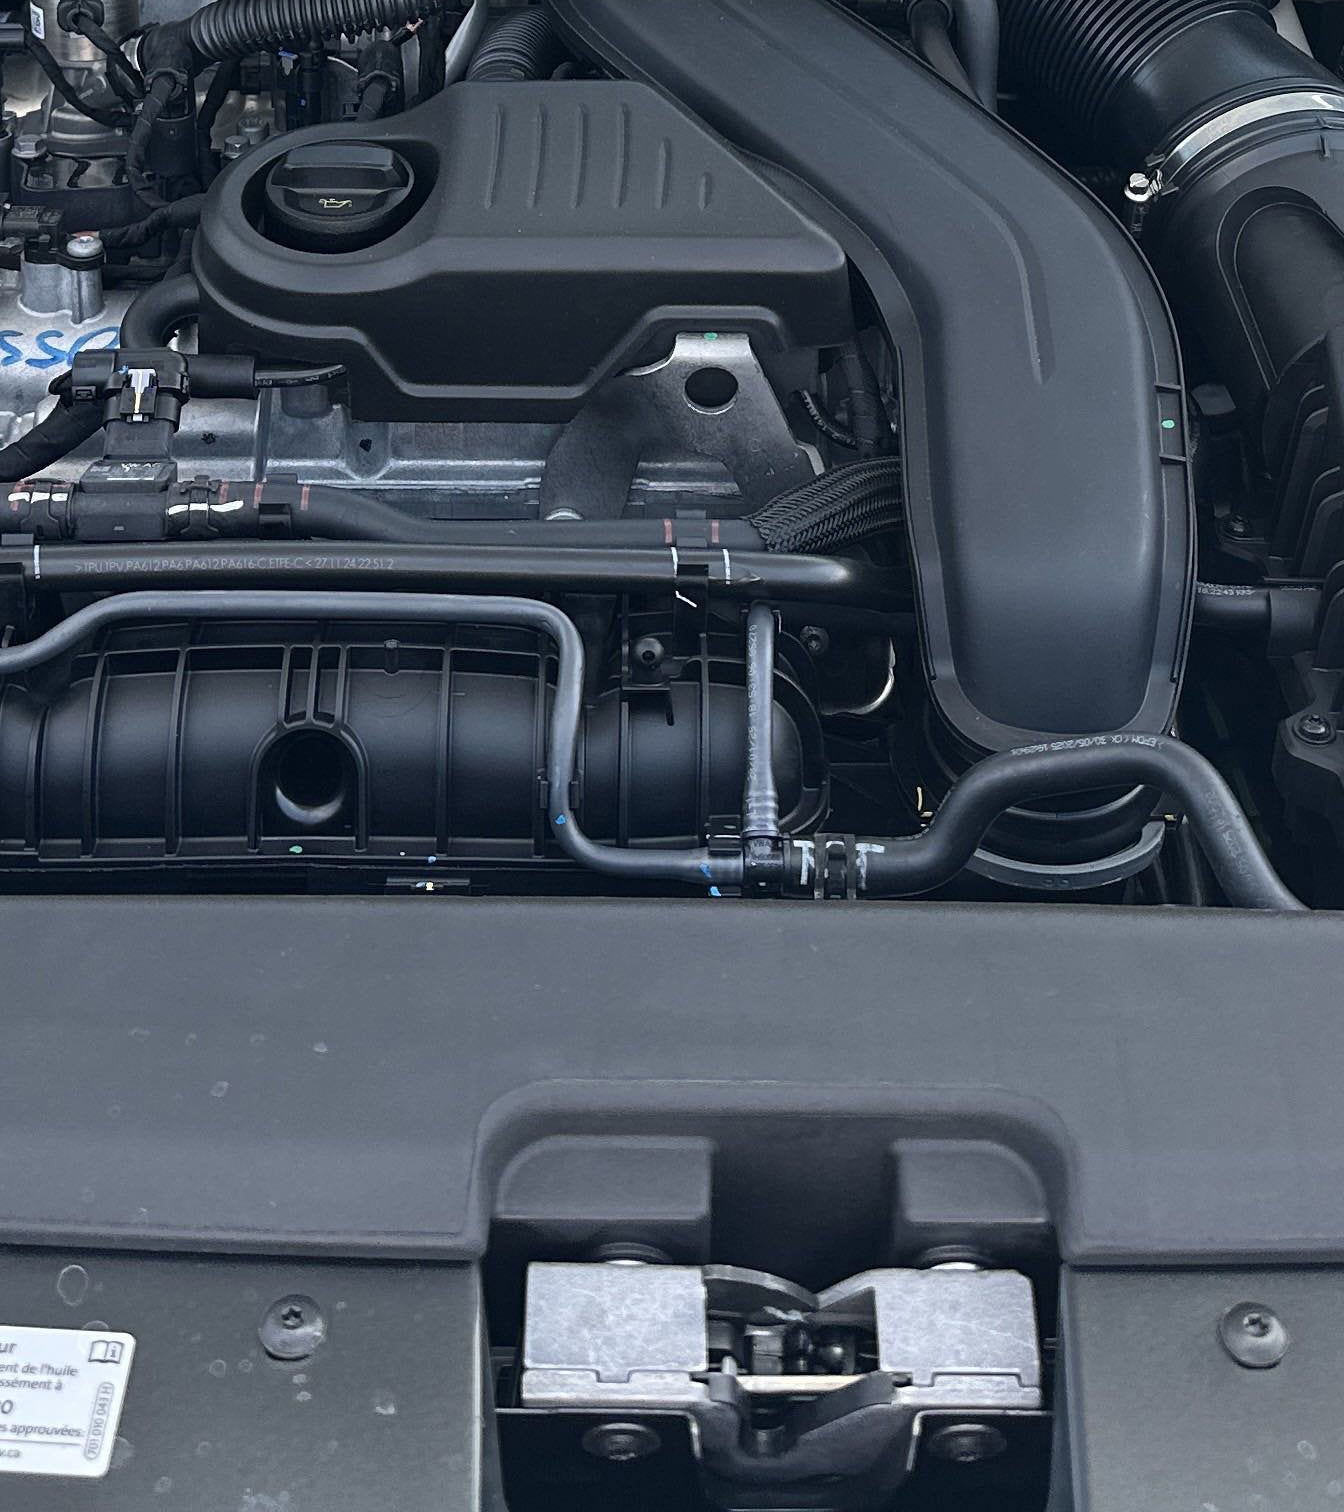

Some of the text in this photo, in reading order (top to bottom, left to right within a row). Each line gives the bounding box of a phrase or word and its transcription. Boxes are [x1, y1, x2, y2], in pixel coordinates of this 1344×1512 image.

[21, 1361, 38, 1375] de
[38, 1362, 78, 1378] l'huile
[53, 1379, 63, 1392] à
[9, 1423, 86, 1439] approuvées:
